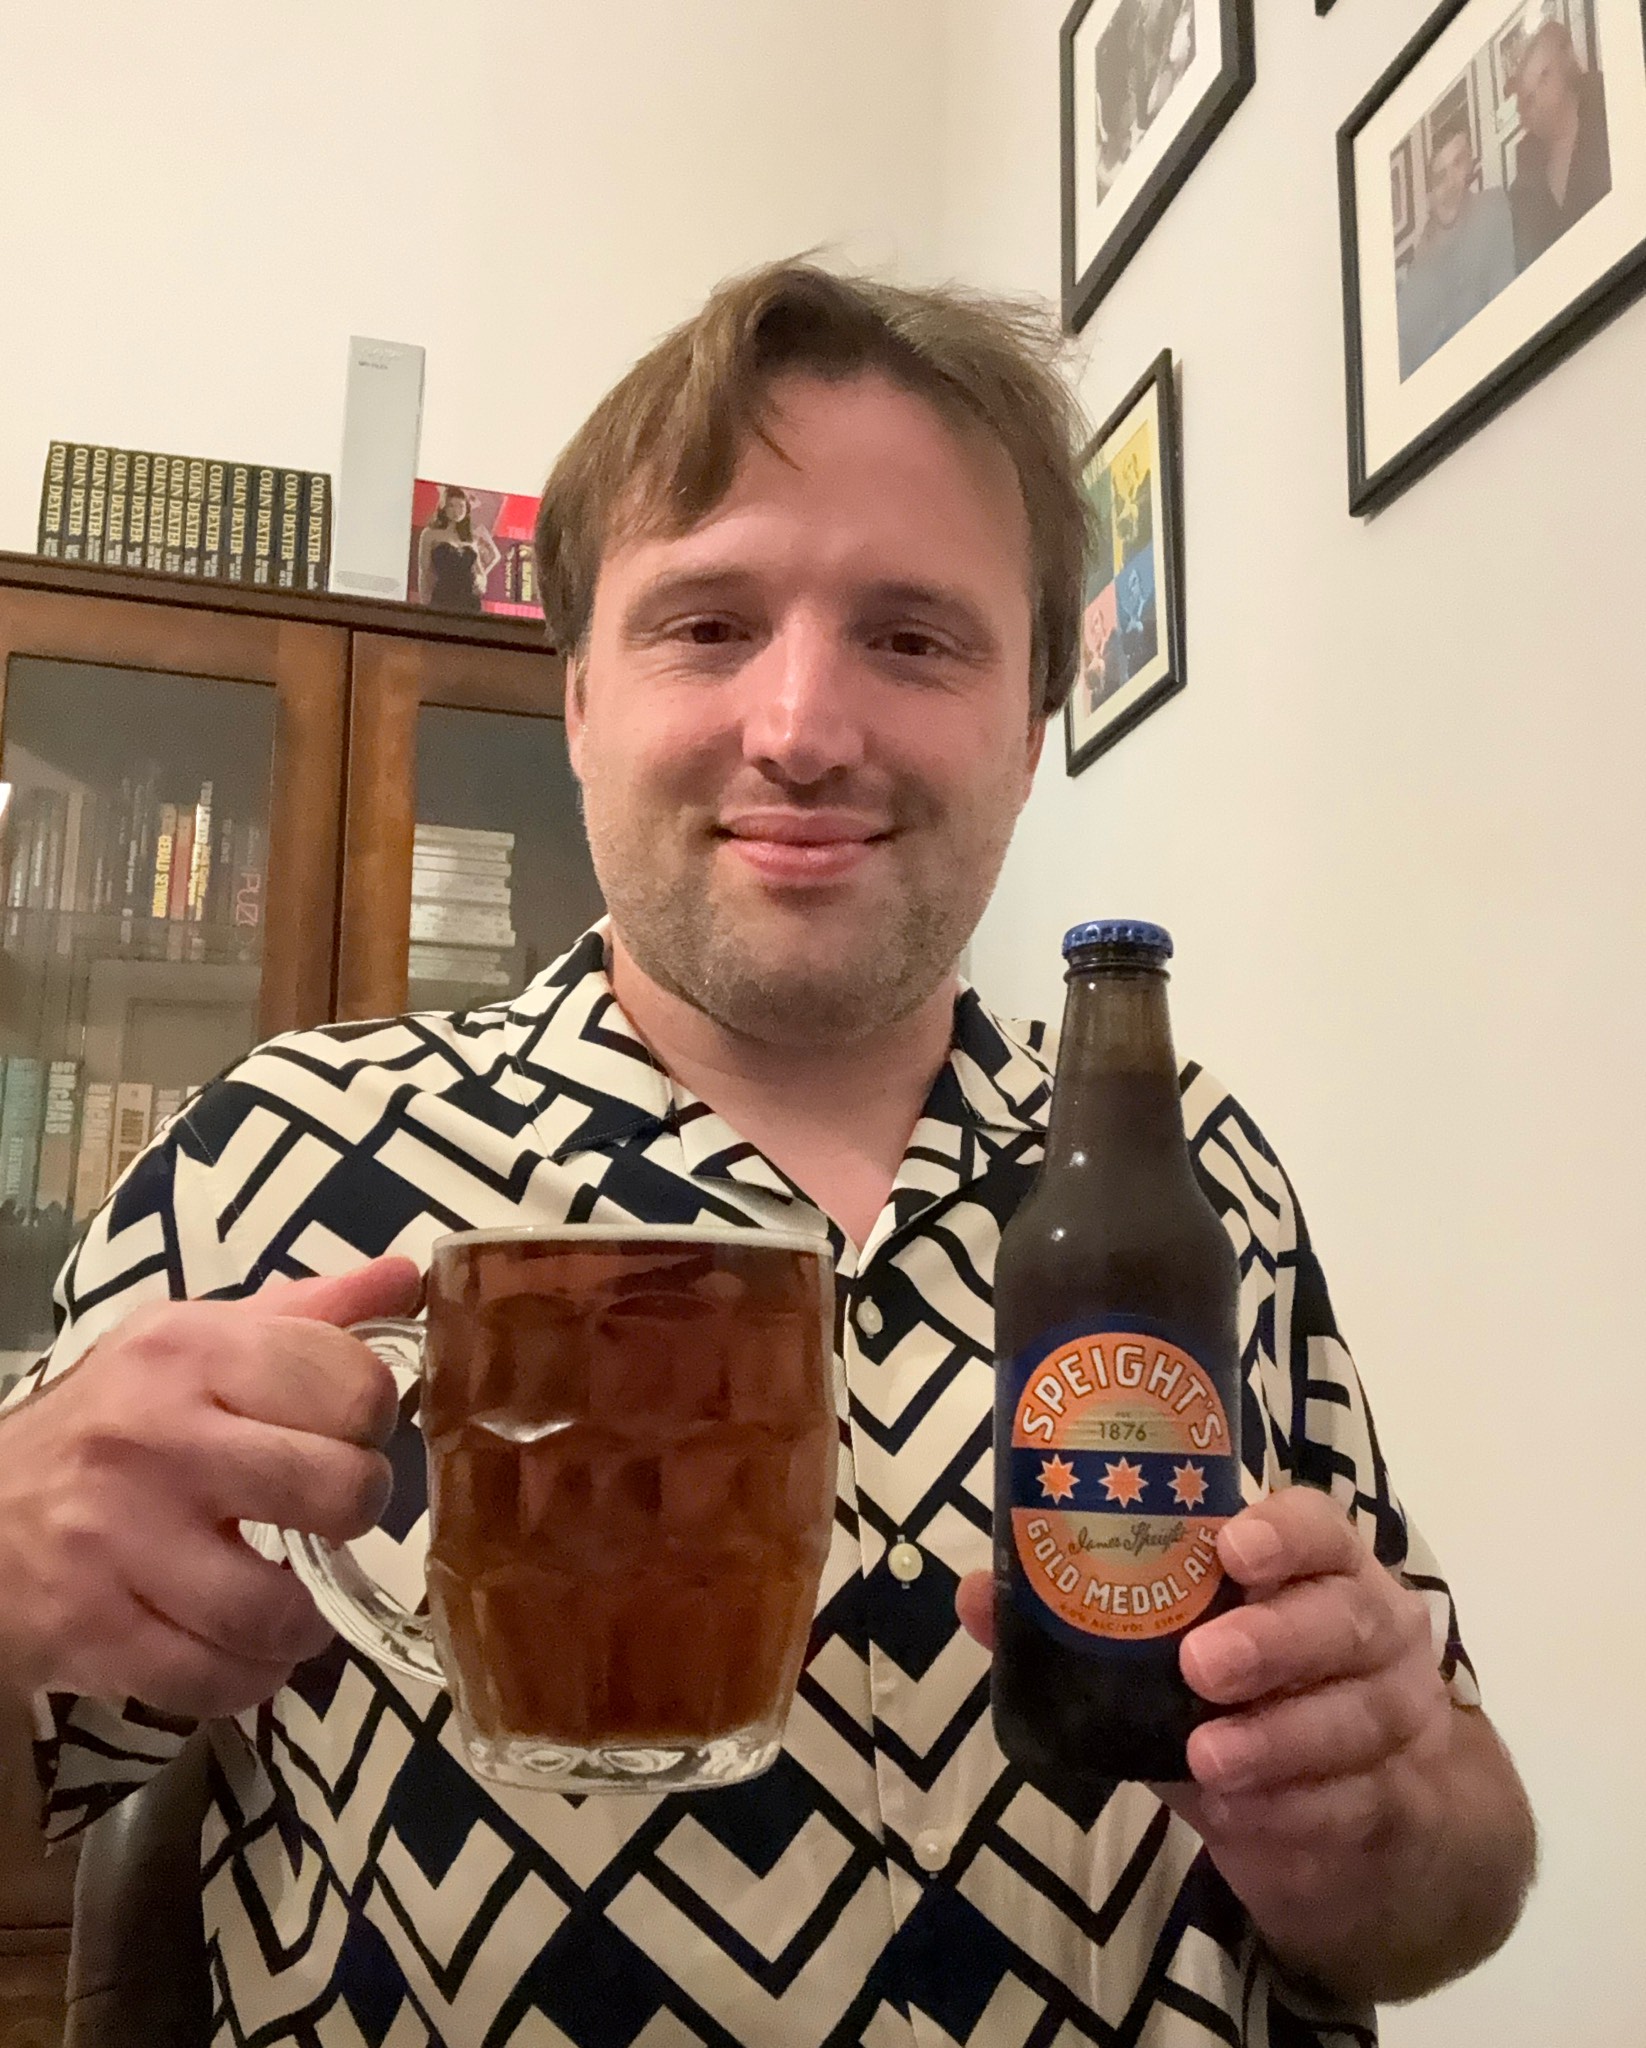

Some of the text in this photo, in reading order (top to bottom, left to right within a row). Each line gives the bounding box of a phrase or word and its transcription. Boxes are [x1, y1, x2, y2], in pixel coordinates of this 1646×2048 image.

[50, 445, 66, 482] COLIN
[72, 448, 88, 485] COLIN
[92, 449, 108, 487] COLIN
[114, 454, 128, 491] COLIN
[134, 455, 148, 492] COLIN
[153, 457, 168, 494] COLIN
[171, 459, 185, 497] COLIN
[189, 462, 202, 498] COLIN
[209, 465, 222, 502] COLIN
[46, 485, 61, 532] DEXTER
[233, 468, 246, 505] COLIN
[259, 470, 273, 506] COLIN
[284, 474, 298, 510] COLIN
[311, 477, 324, 513] COLIN
[69, 488, 84, 536] DEXTER
[88, 489, 104, 536] DEXTER
[109, 494, 124, 541] DEXTER
[130, 496, 145, 542] DEXTER
[149, 496, 164, 543] DEXTER
[167, 500, 182, 546] DEXTER
[186, 502, 200, 548] DEXTER
[206, 505, 220, 551] DEXTER
[230, 508, 245, 554] DEXTER
[256, 510, 271, 556] DEXTER
[281, 514, 295, 560] DEXTER
[308, 517, 322, 562] DEXTER
[1022, 1343, 1222, 1449] SPEIGHT'S
[1098, 1421, 1148, 1441] 1876
[1027, 1517, 1081, 1594] GOLD
[1084, 1574, 1189, 1615] MEDAL
